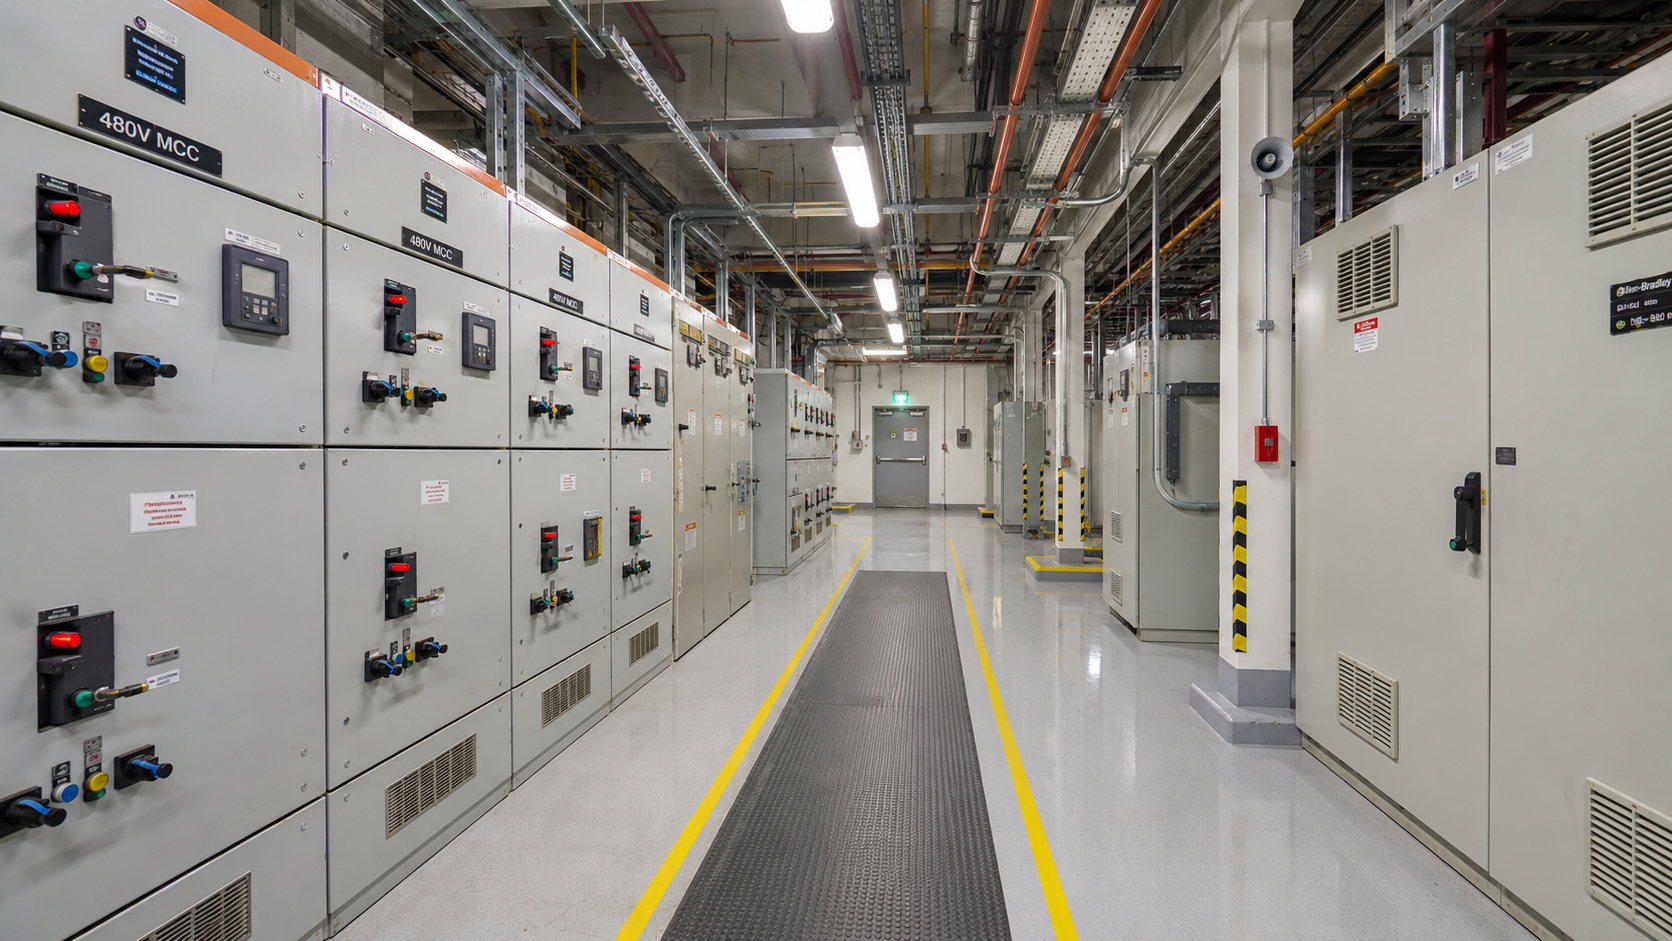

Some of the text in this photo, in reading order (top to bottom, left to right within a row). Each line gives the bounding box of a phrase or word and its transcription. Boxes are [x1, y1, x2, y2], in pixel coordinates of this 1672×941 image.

[99, 112, 200, 162] 480V MCC
[410, 235, 453, 260] 480V MCC
